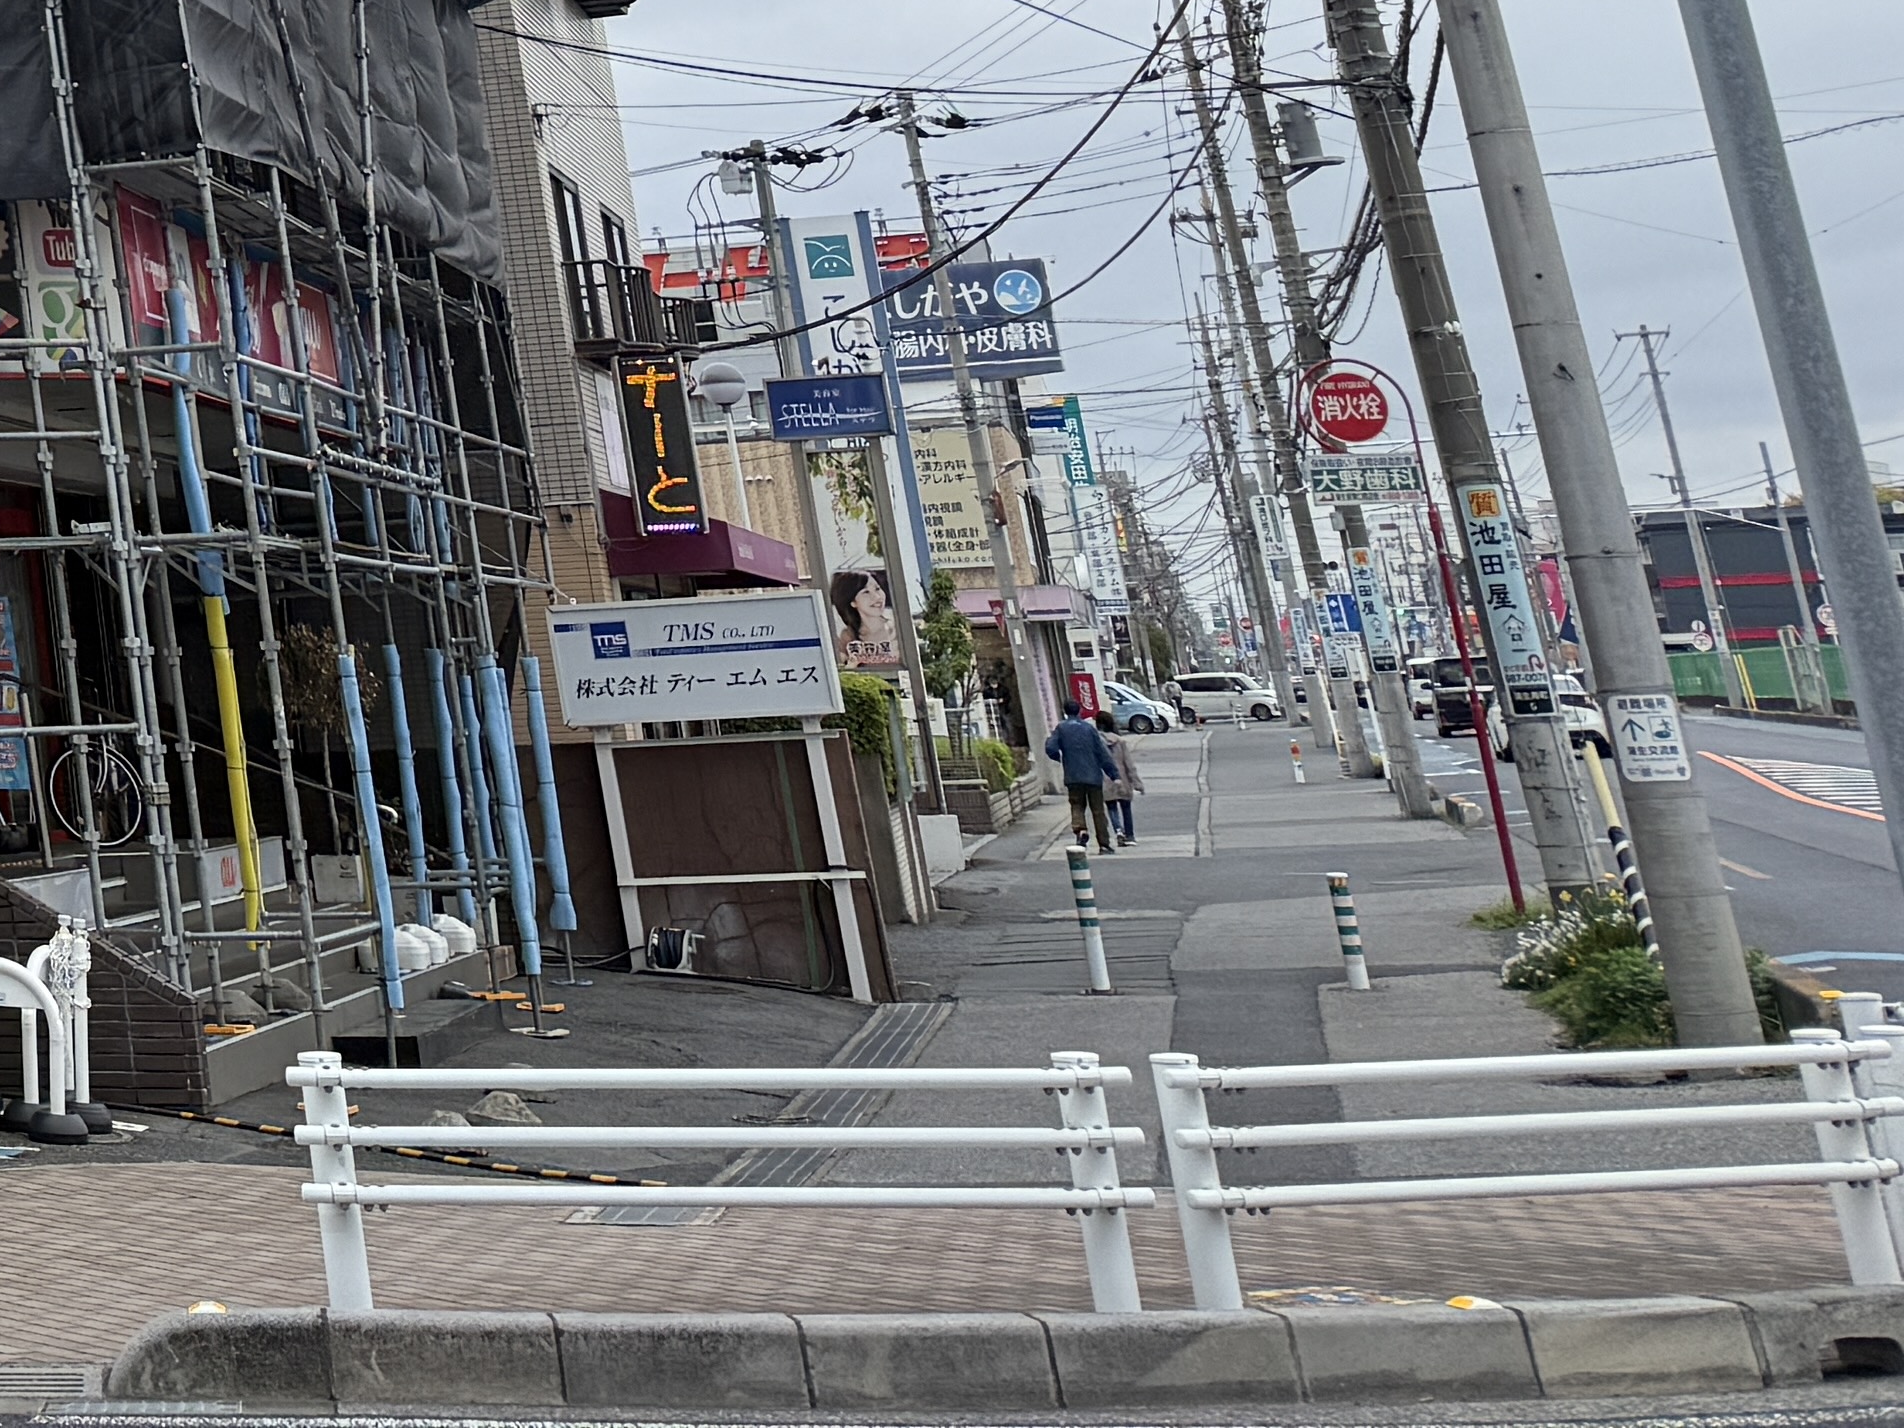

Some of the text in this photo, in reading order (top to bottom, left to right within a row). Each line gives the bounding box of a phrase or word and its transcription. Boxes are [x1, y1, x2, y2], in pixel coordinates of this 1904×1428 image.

[45, 234, 77, 261] Tub
[780, 403, 840, 428] STELLA
[1317, 392, 1384, 422] 消火栓
[1313, 467, 1417, 492] 大野歯科
[1469, 520, 1517, 611] 池田屋
[662, 622, 716, 643] TMS
[576, 665, 821, 699] 株式会社 ティー エム エス
